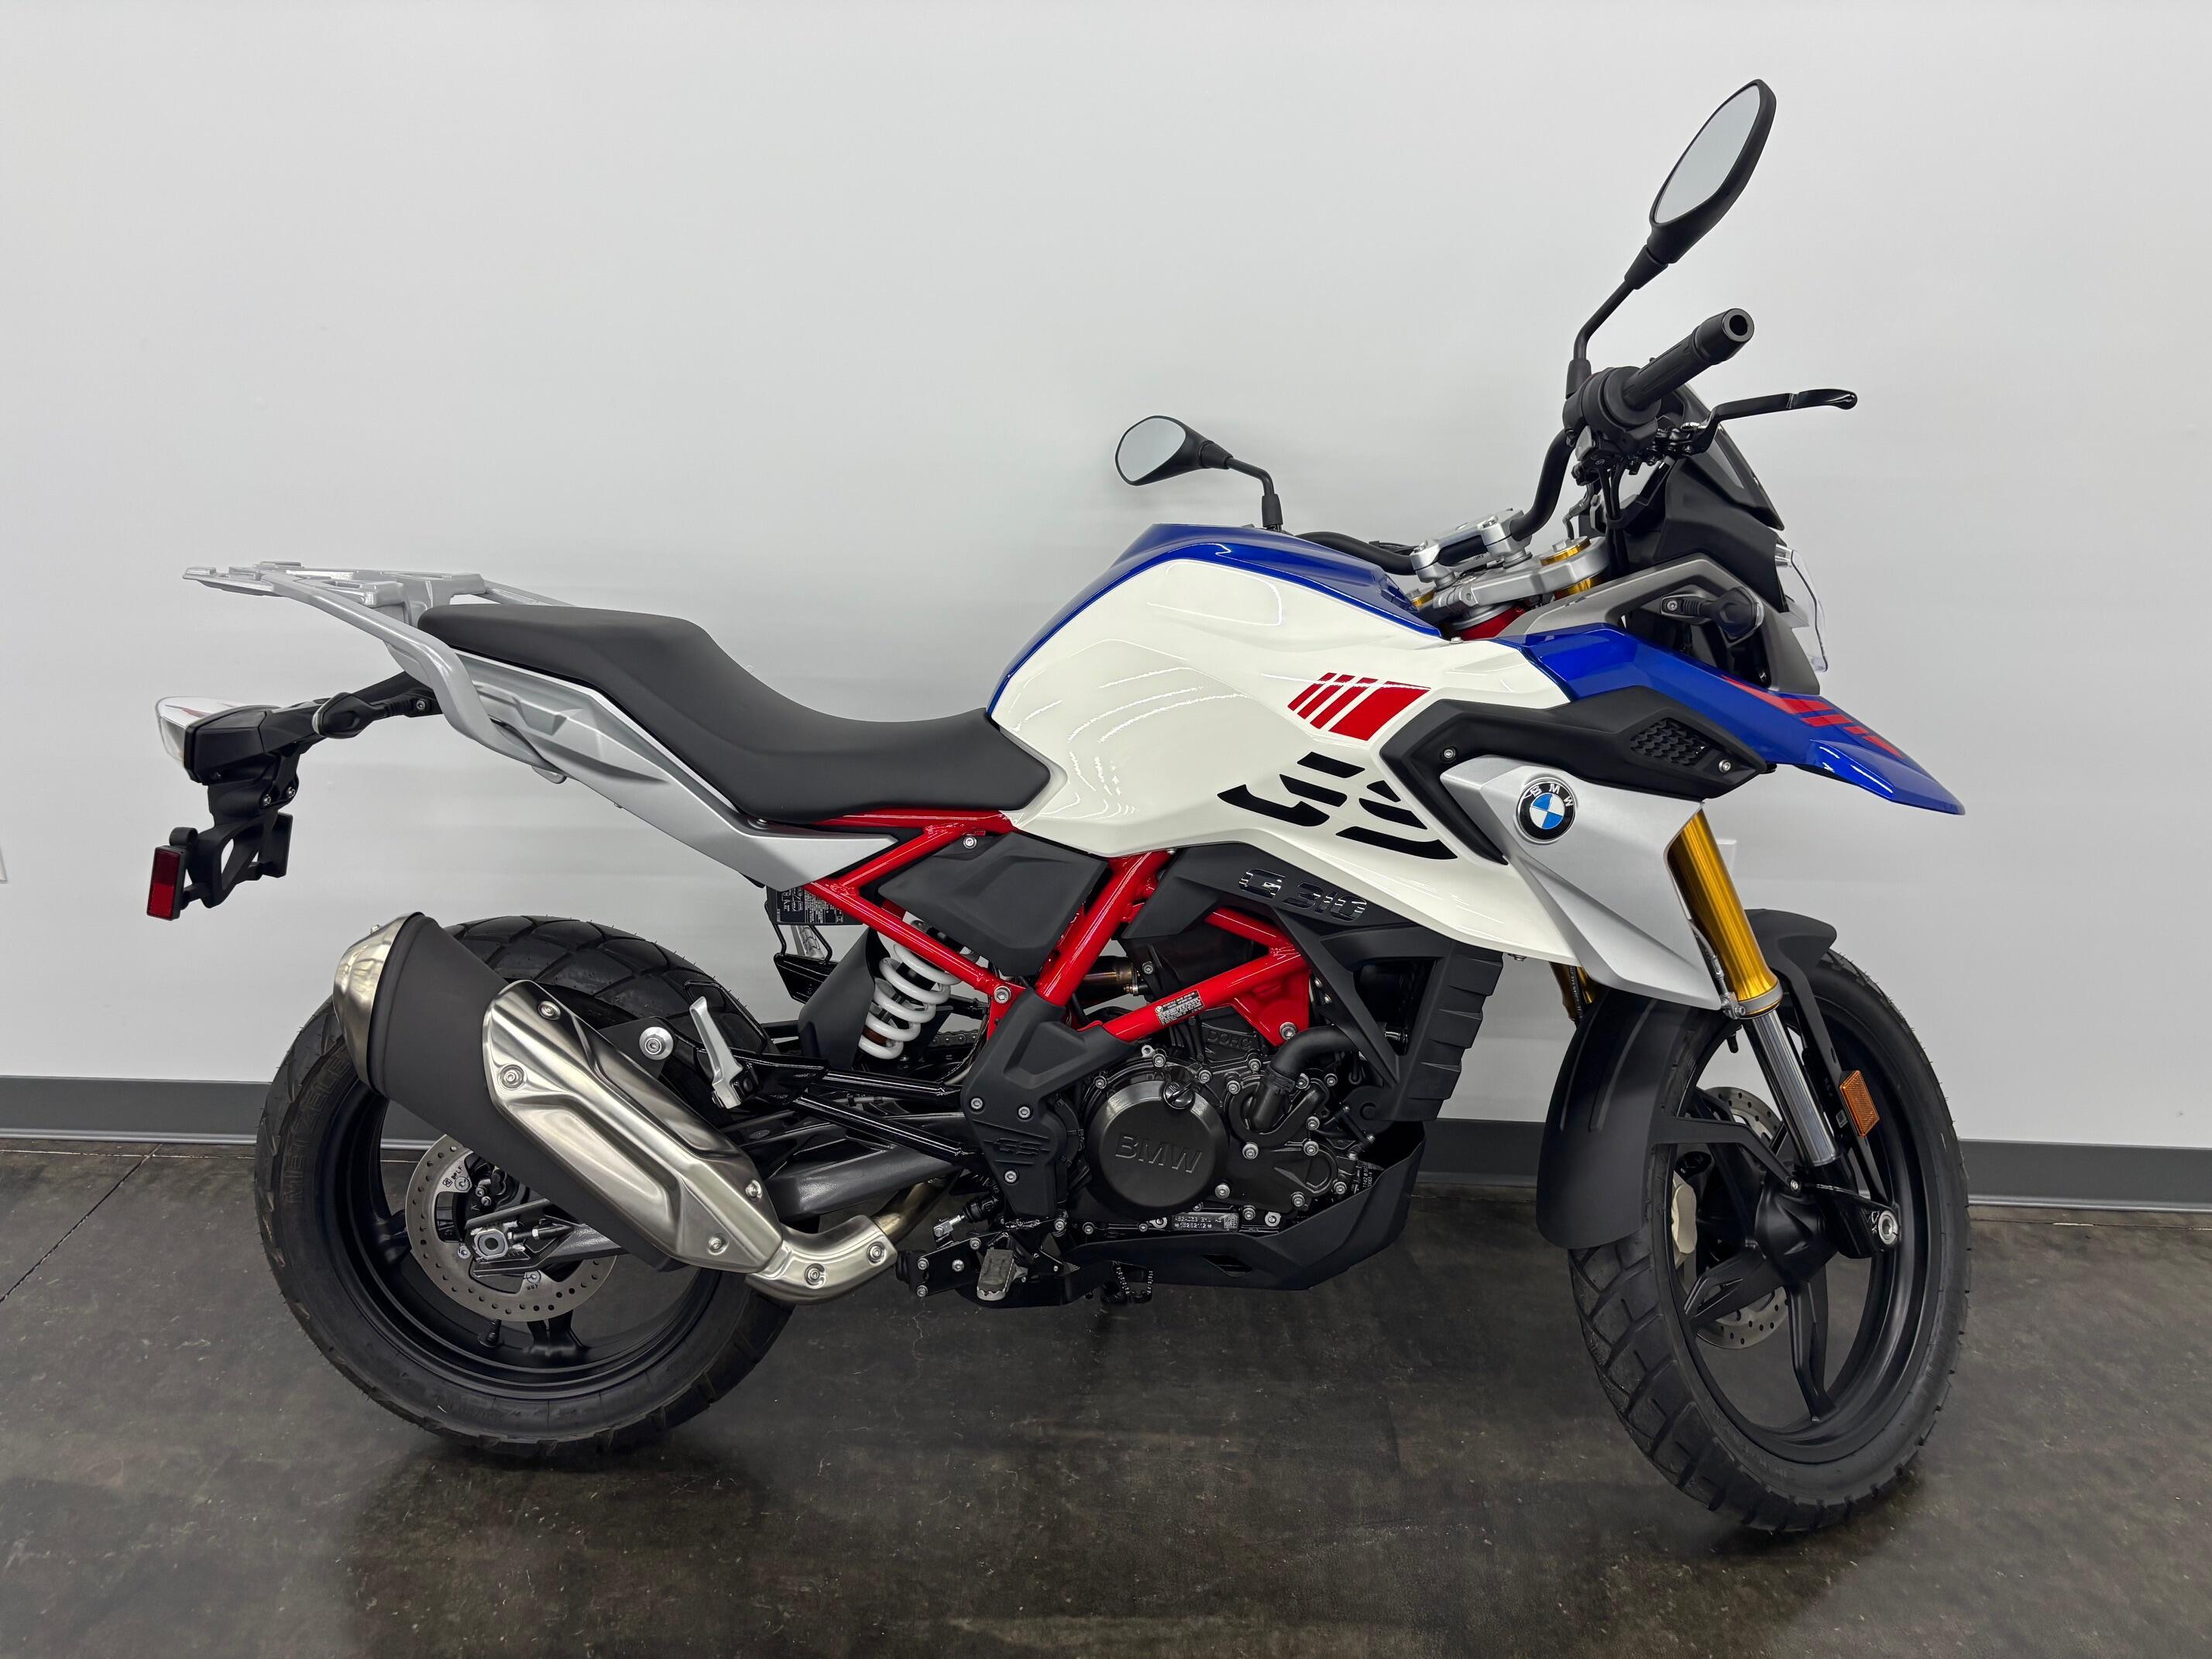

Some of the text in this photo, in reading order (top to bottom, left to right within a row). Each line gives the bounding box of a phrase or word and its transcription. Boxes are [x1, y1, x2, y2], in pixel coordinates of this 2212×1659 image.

[1530, 783, 1574, 807] BMW
[1238, 868, 1368, 922] G 310
[1207, 1030, 1252, 1049] DOHC
[283, 1048, 352, 1204] METZELE
[1115, 1134, 1202, 1174] BMW
